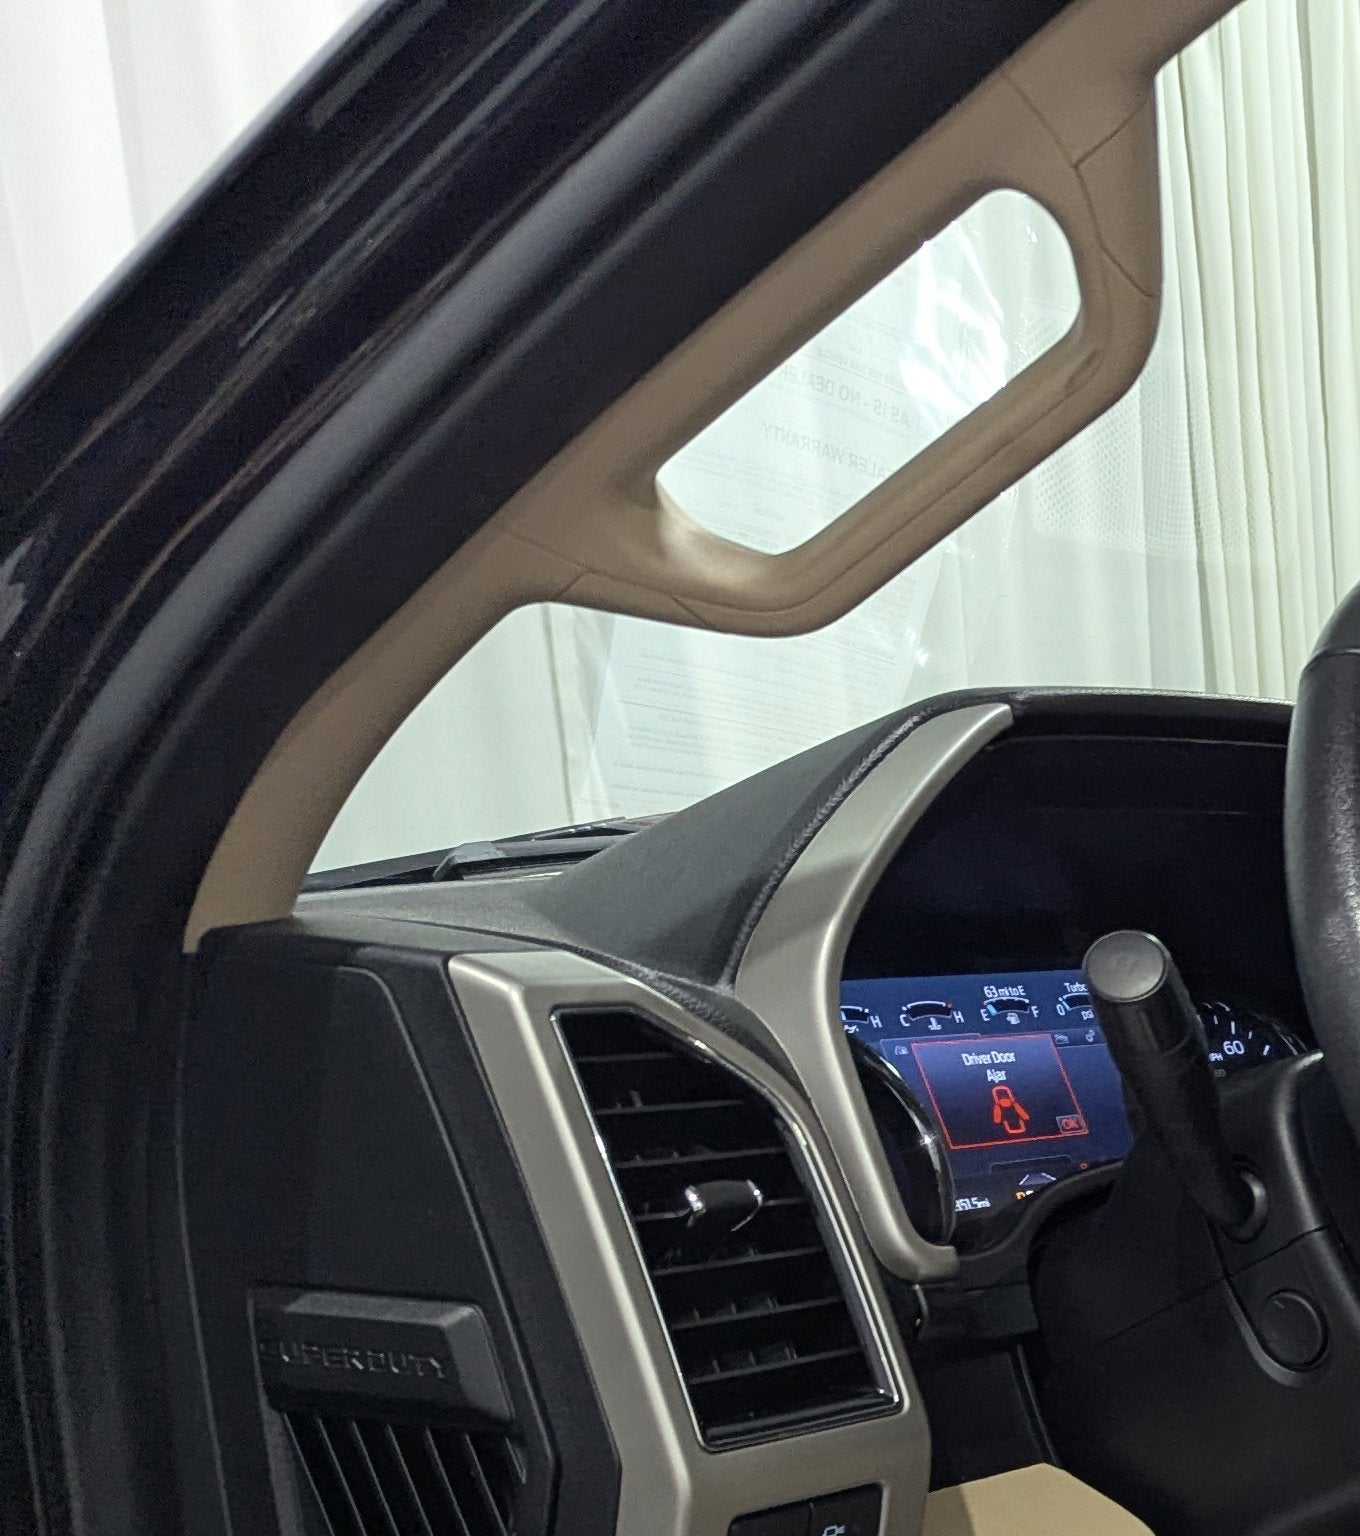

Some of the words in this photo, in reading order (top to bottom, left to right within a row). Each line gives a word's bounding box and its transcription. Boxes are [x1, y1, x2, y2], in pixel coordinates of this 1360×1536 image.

[984, 985, 998, 998] 63
[953, 1009, 965, 1024] H
[980, 1008, 991, 1022] E
[1031, 1005, 1040, 1019] F
[870, 1014, 883, 1029] H
[900, 1013, 911, 1028] C
[1222, 1040, 1245, 1055] 60
[961, 1052, 992, 1066] Driver
[991, 1050, 1017, 1064] Door
[986, 1068, 1007, 1083] Ajar
